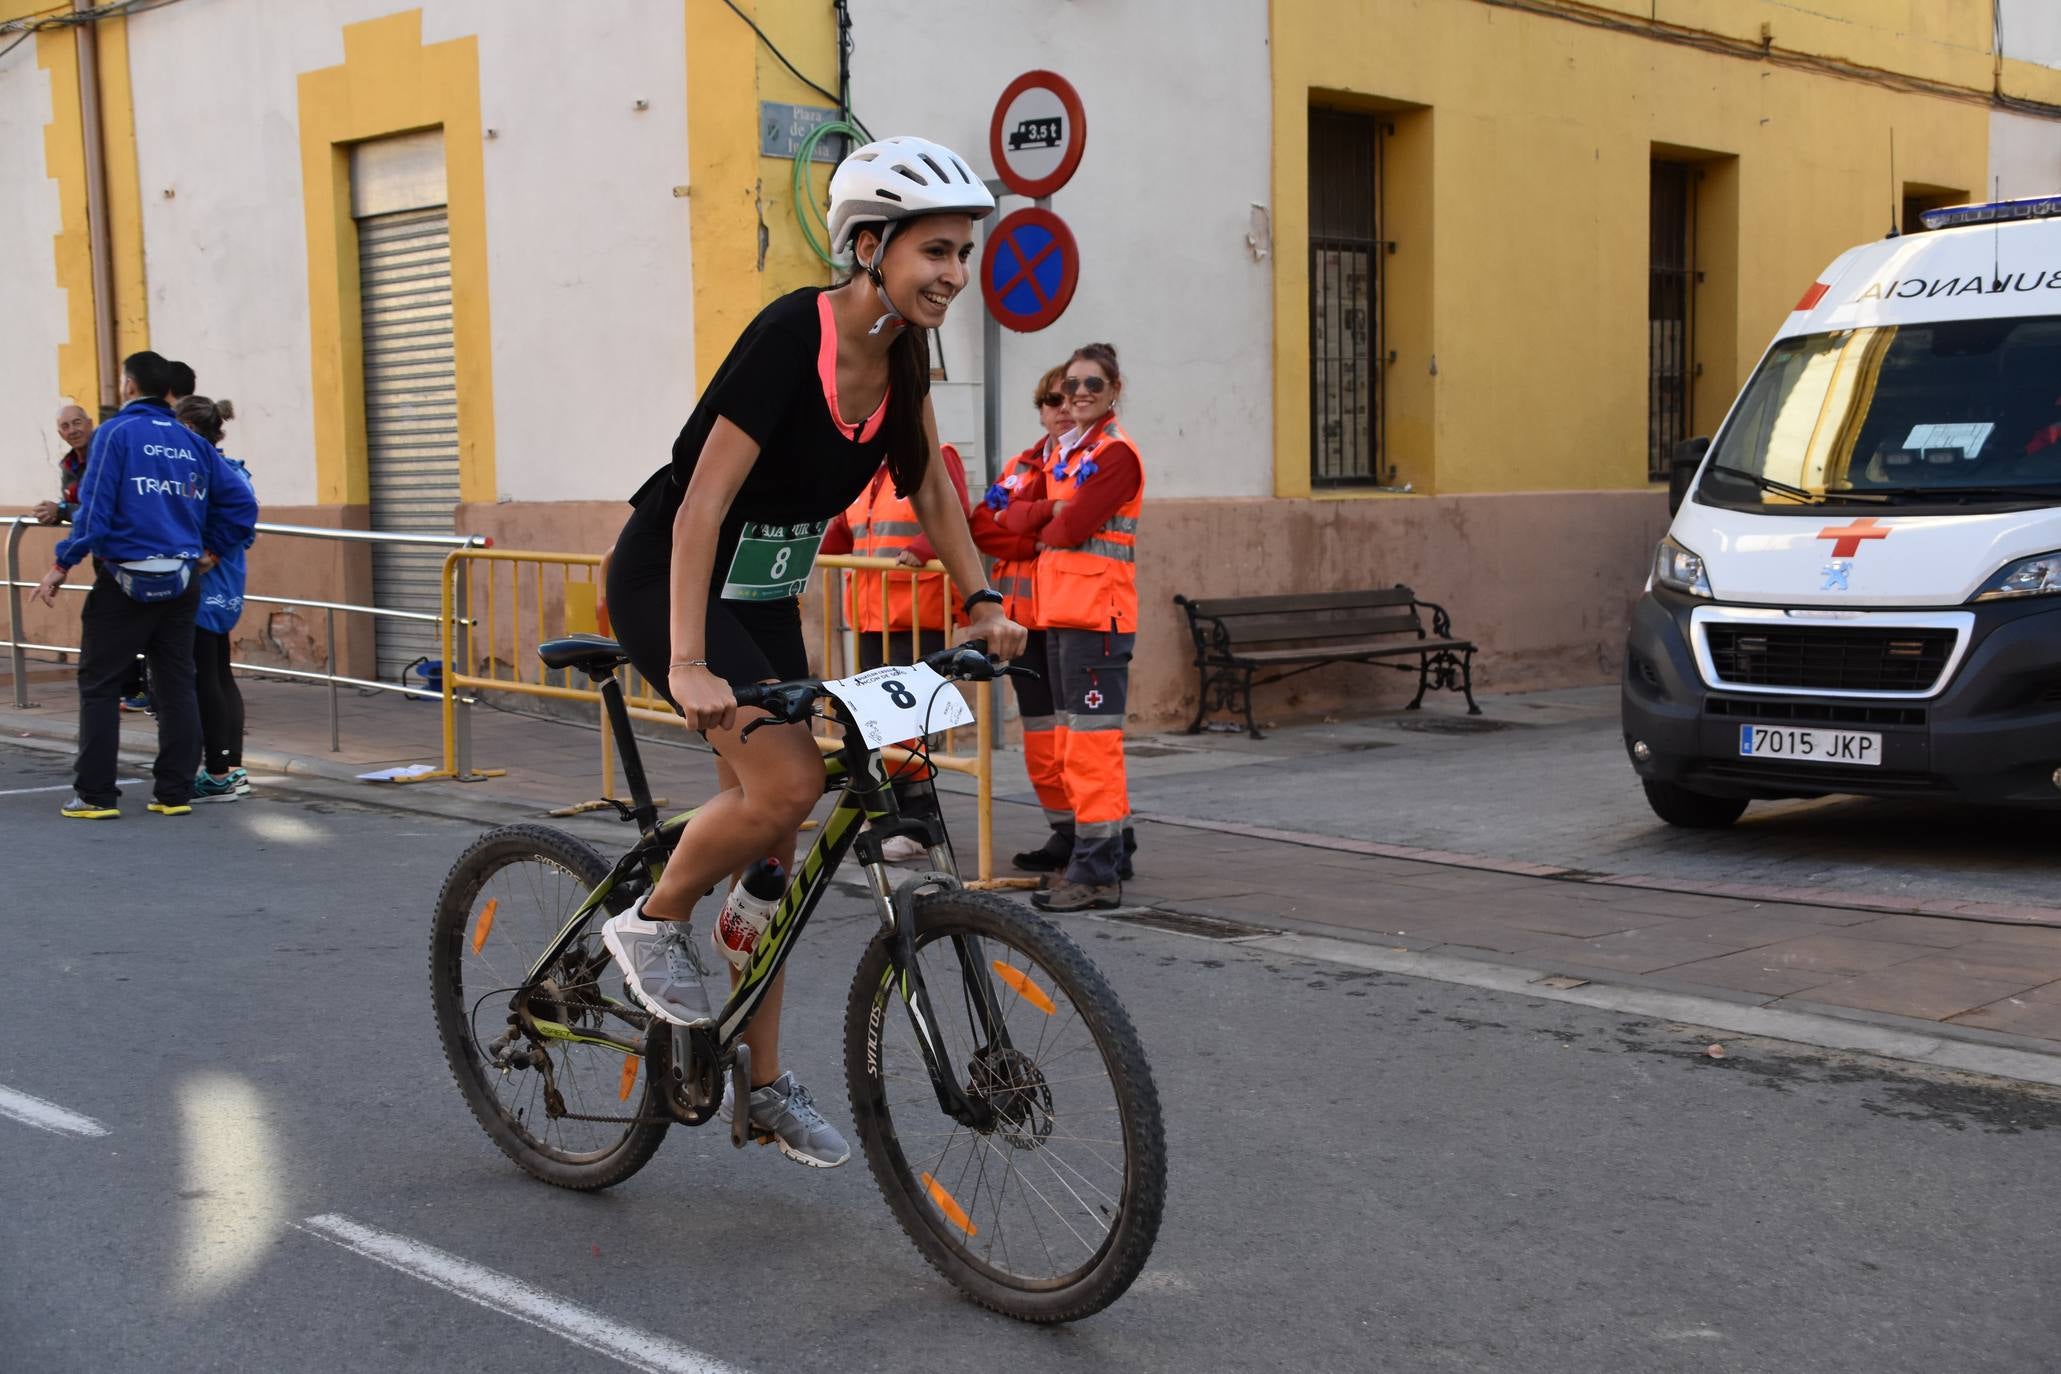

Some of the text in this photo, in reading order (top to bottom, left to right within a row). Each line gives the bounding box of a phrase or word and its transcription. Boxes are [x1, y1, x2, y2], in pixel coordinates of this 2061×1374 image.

[793, 106, 822, 121] Plaza
[789, 121, 805, 137] de
[1028, 123, 1057, 139] 3,5 t
[770, 546, 791, 580] 8
[881, 680, 917, 710] 8
[1755, 729, 1813, 754] 7015
[1826, 734, 1872, 760] JKP
[867, 1001, 881, 1080] SYNCROS
